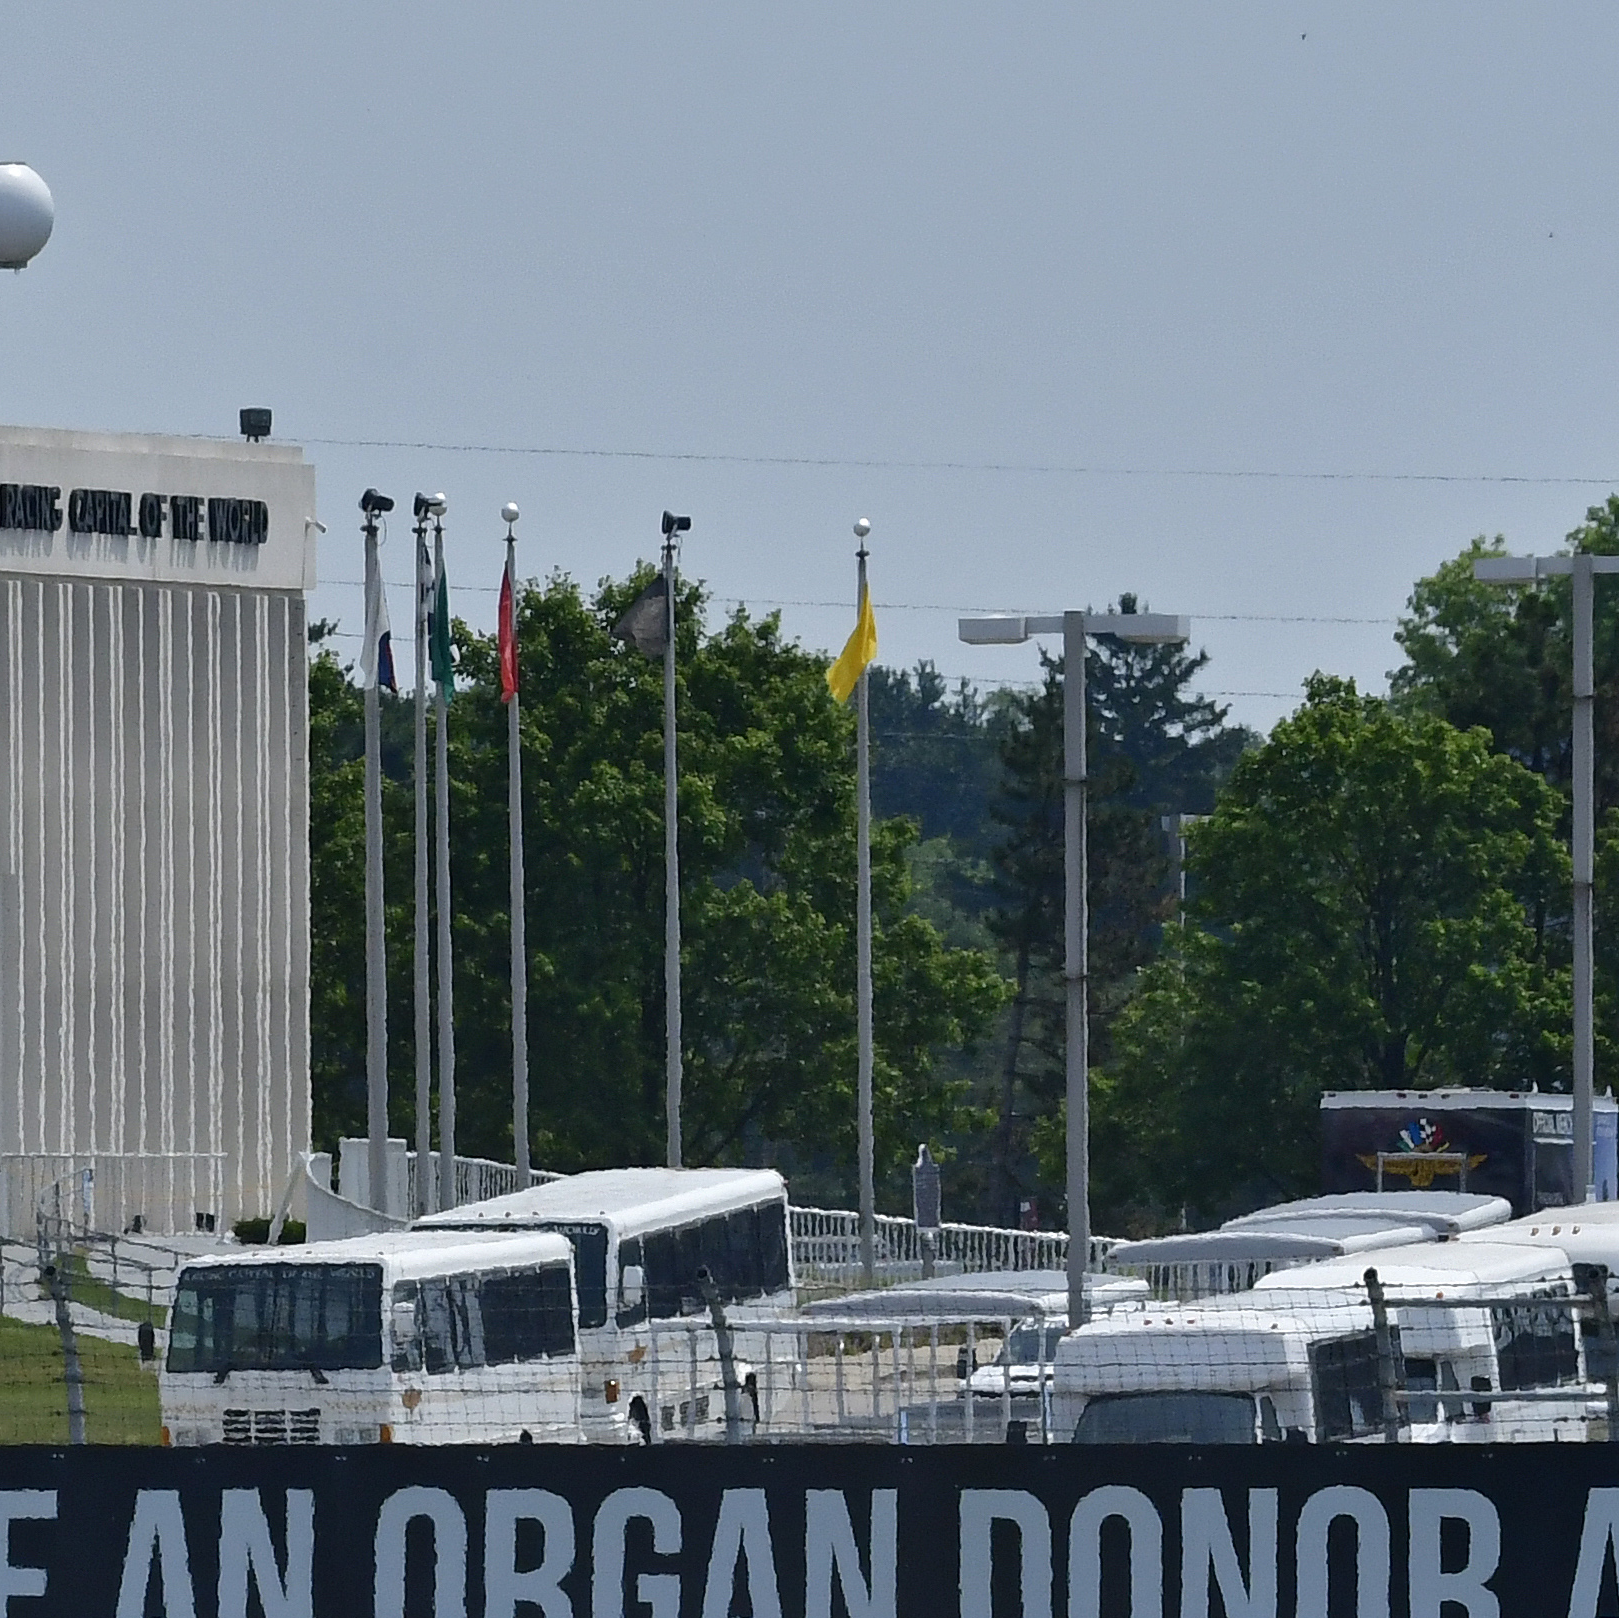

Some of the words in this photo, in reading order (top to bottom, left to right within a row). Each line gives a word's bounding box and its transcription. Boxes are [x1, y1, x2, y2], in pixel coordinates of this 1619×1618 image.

[0, 483, 63, 531] RACING
[68, 488, 137, 535] CAPITAL
[139, 493, 168, 538] OF
[169, 495, 205, 541] THE
[208, 497, 268, 544] WORLD
